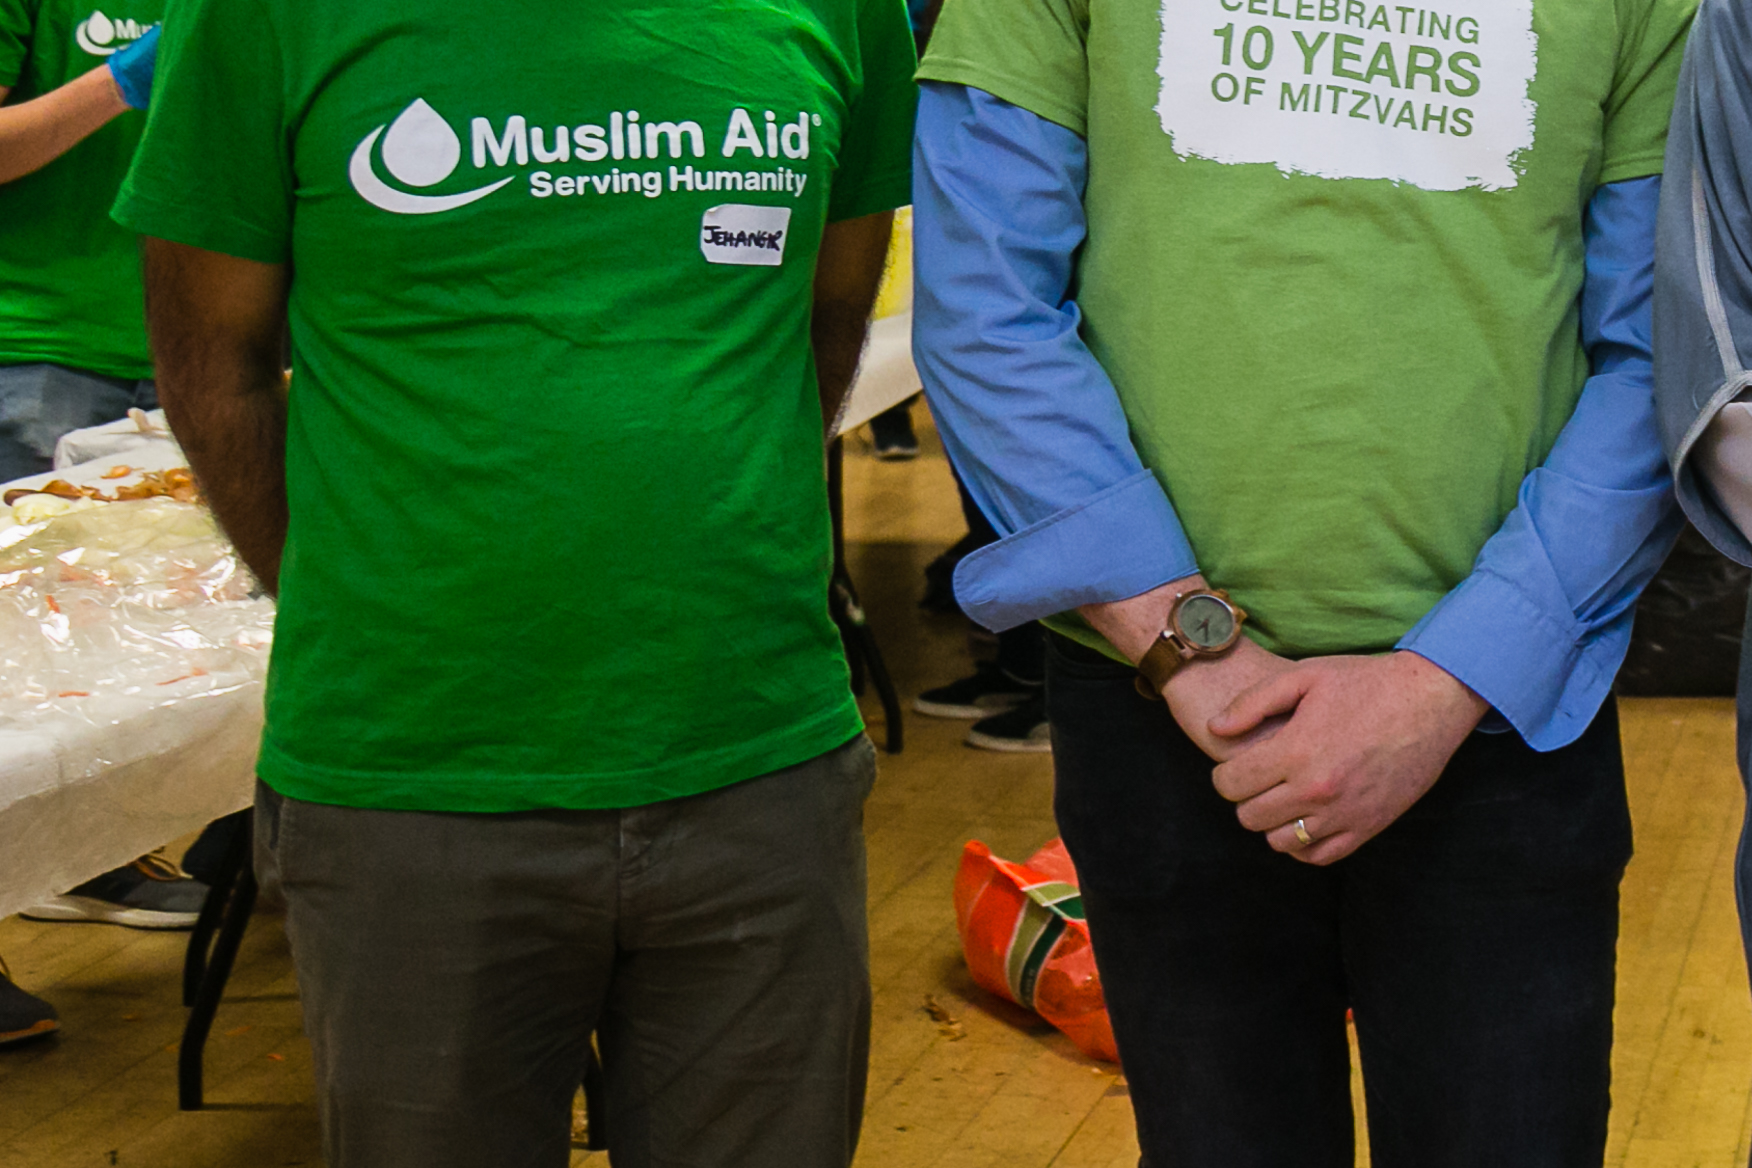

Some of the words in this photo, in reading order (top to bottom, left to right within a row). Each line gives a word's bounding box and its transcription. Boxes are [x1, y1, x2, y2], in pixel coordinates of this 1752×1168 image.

[1212, 22, 1275, 71] 10
[1292, 30, 1482, 98] YEARS
[1211, 72, 1266, 105] OF
[1279, 82, 1474, 138] MITZVAHS
[471, 111, 705, 169] Muslim
[530, 167, 662, 199] Serving
[668, 165, 808, 197] Humanity
